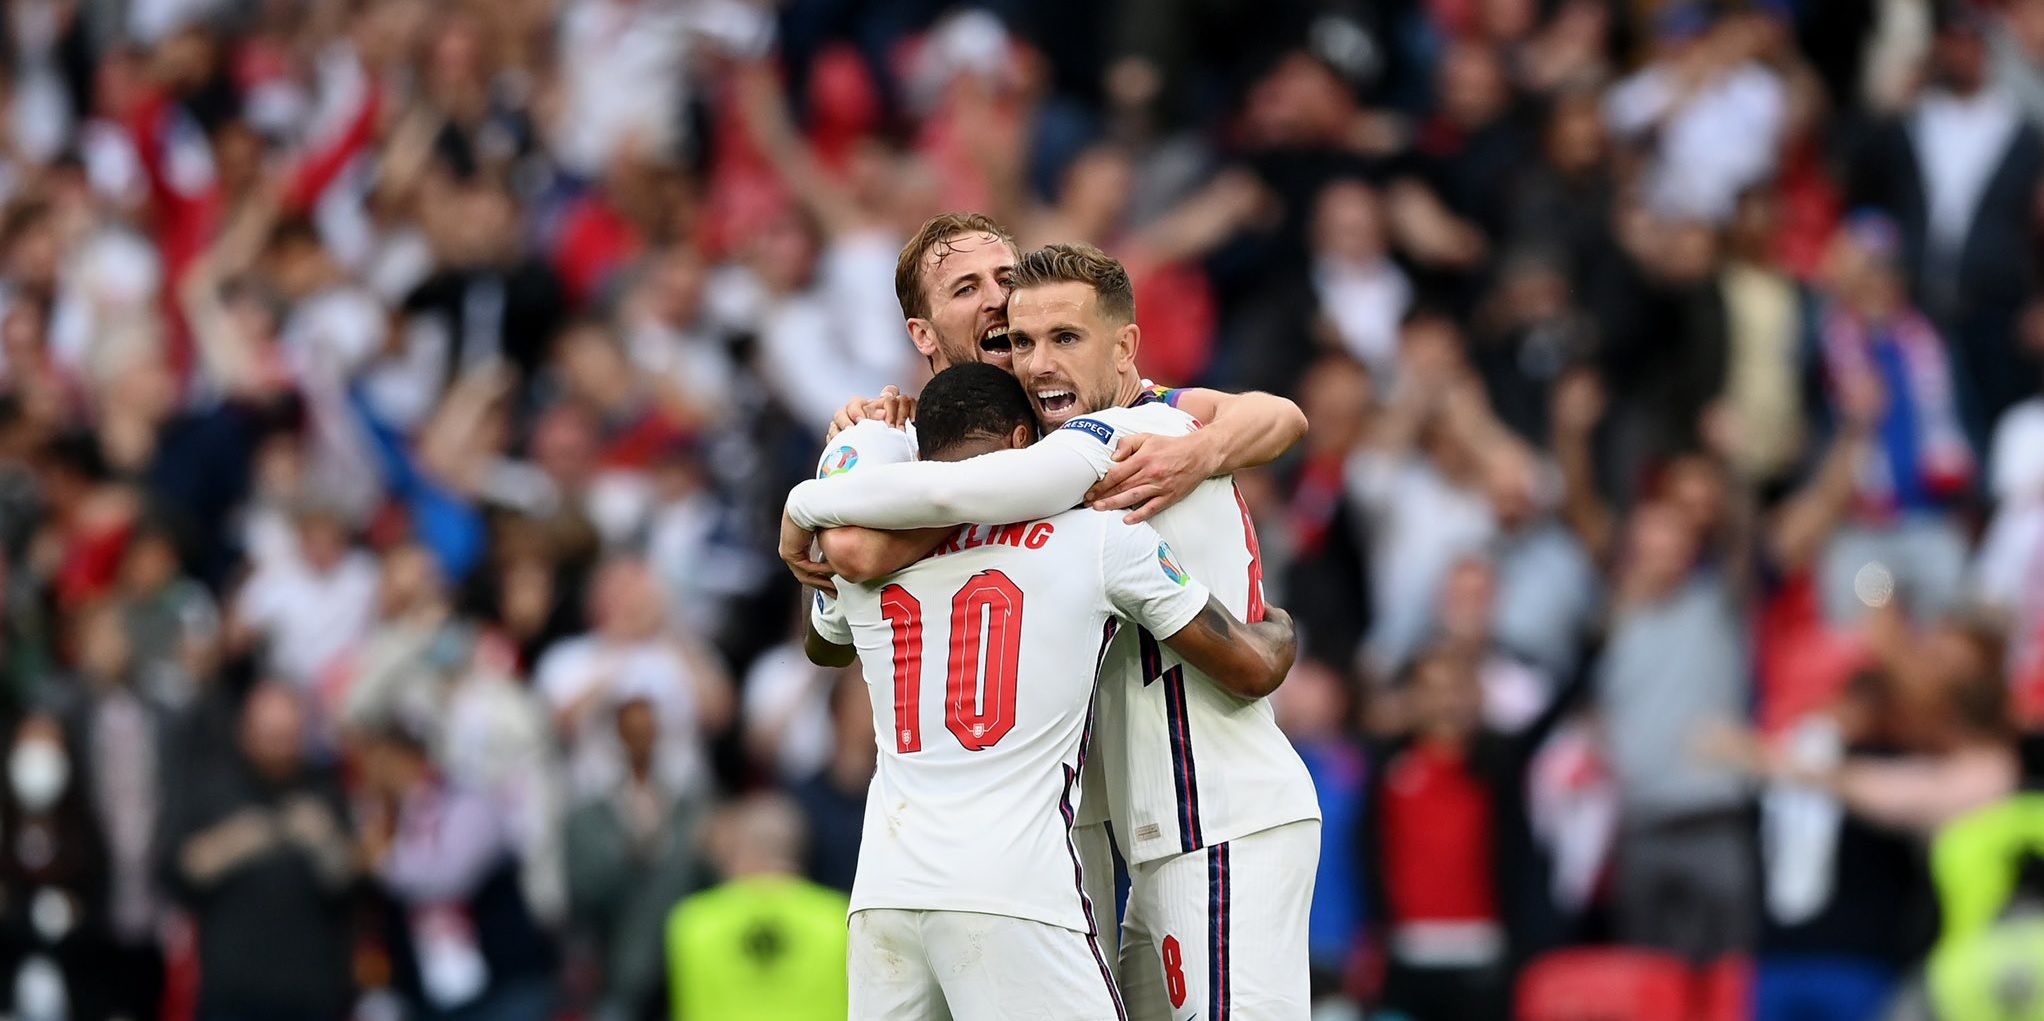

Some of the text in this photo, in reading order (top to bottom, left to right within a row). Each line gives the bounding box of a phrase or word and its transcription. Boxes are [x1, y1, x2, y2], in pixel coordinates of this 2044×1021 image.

[1064, 420, 1112, 439] RESPECT
[921, 522, 1055, 557] RLING
[881, 569, 1024, 753] 10
[1162, 934, 1187, 1009] 8
